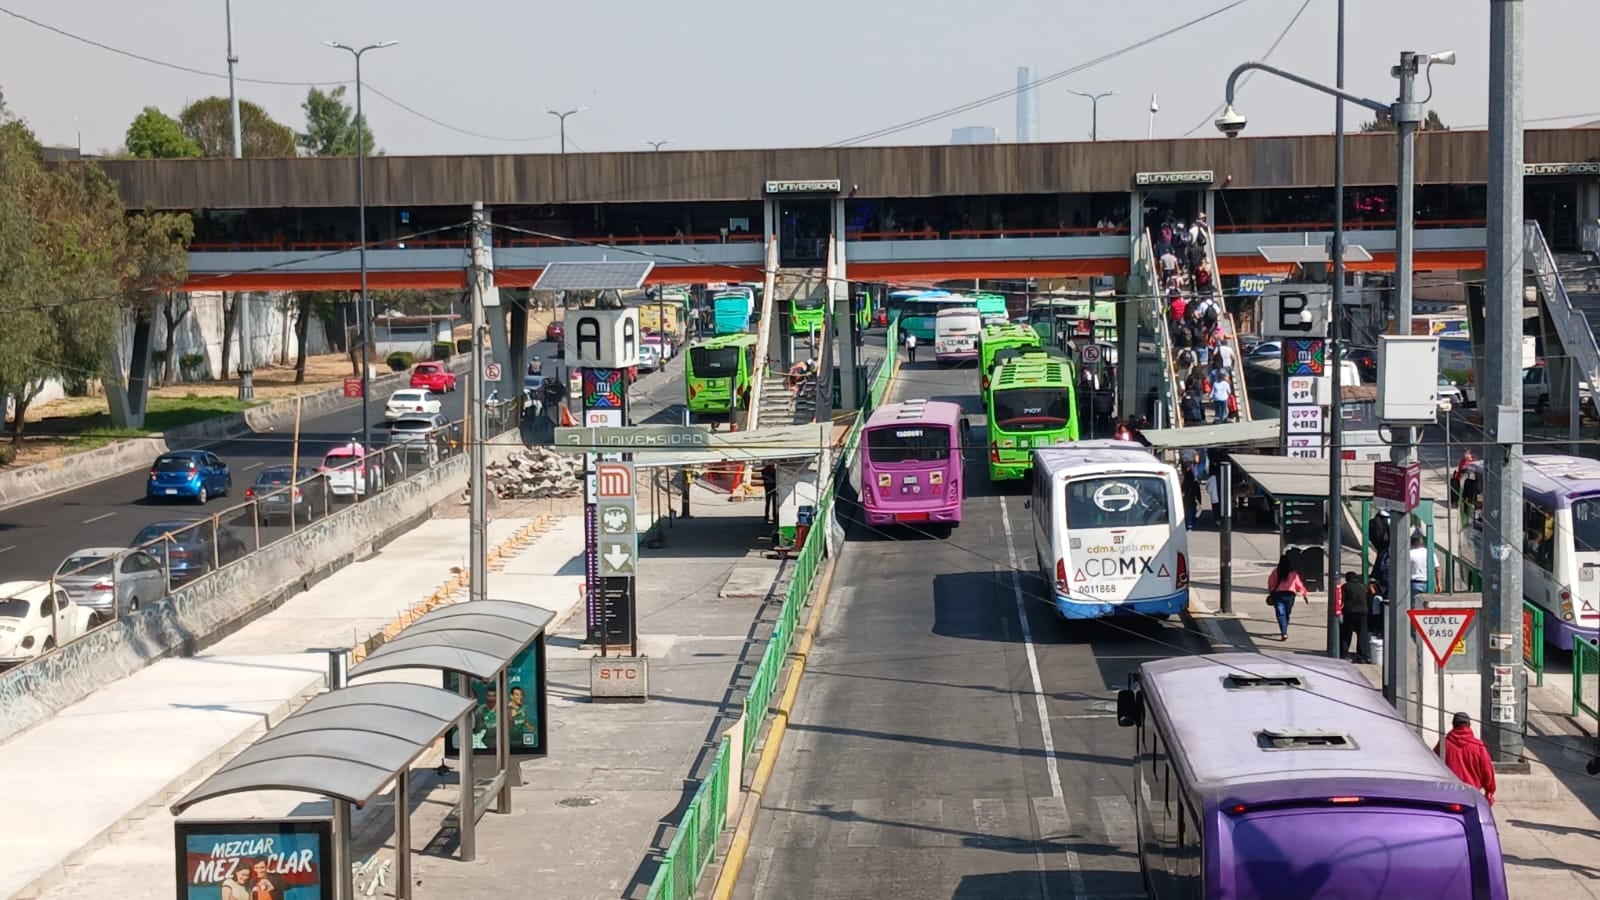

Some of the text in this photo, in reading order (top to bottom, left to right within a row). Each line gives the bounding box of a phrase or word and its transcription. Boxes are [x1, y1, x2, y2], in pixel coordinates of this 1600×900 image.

[1279, 291, 1308, 331] B
[577, 317, 601, 361] A
[623, 316, 635, 361] A
[567, 434, 704, 446] 3 UNIVERSIDAD
[1087, 543, 1156, 555] cdmx.gob.mx
[1085, 556, 1154, 578] CDMX
[1079, 584, 1117, 594] 0011868
[1422, 616, 1460, 625] CEDA EL
[1428, 629, 1454, 638] PASO
[600, 668, 637, 680] STC
[211, 837, 274, 859] MEZCLAR
[193, 848, 314, 884] MEZ CLAR
